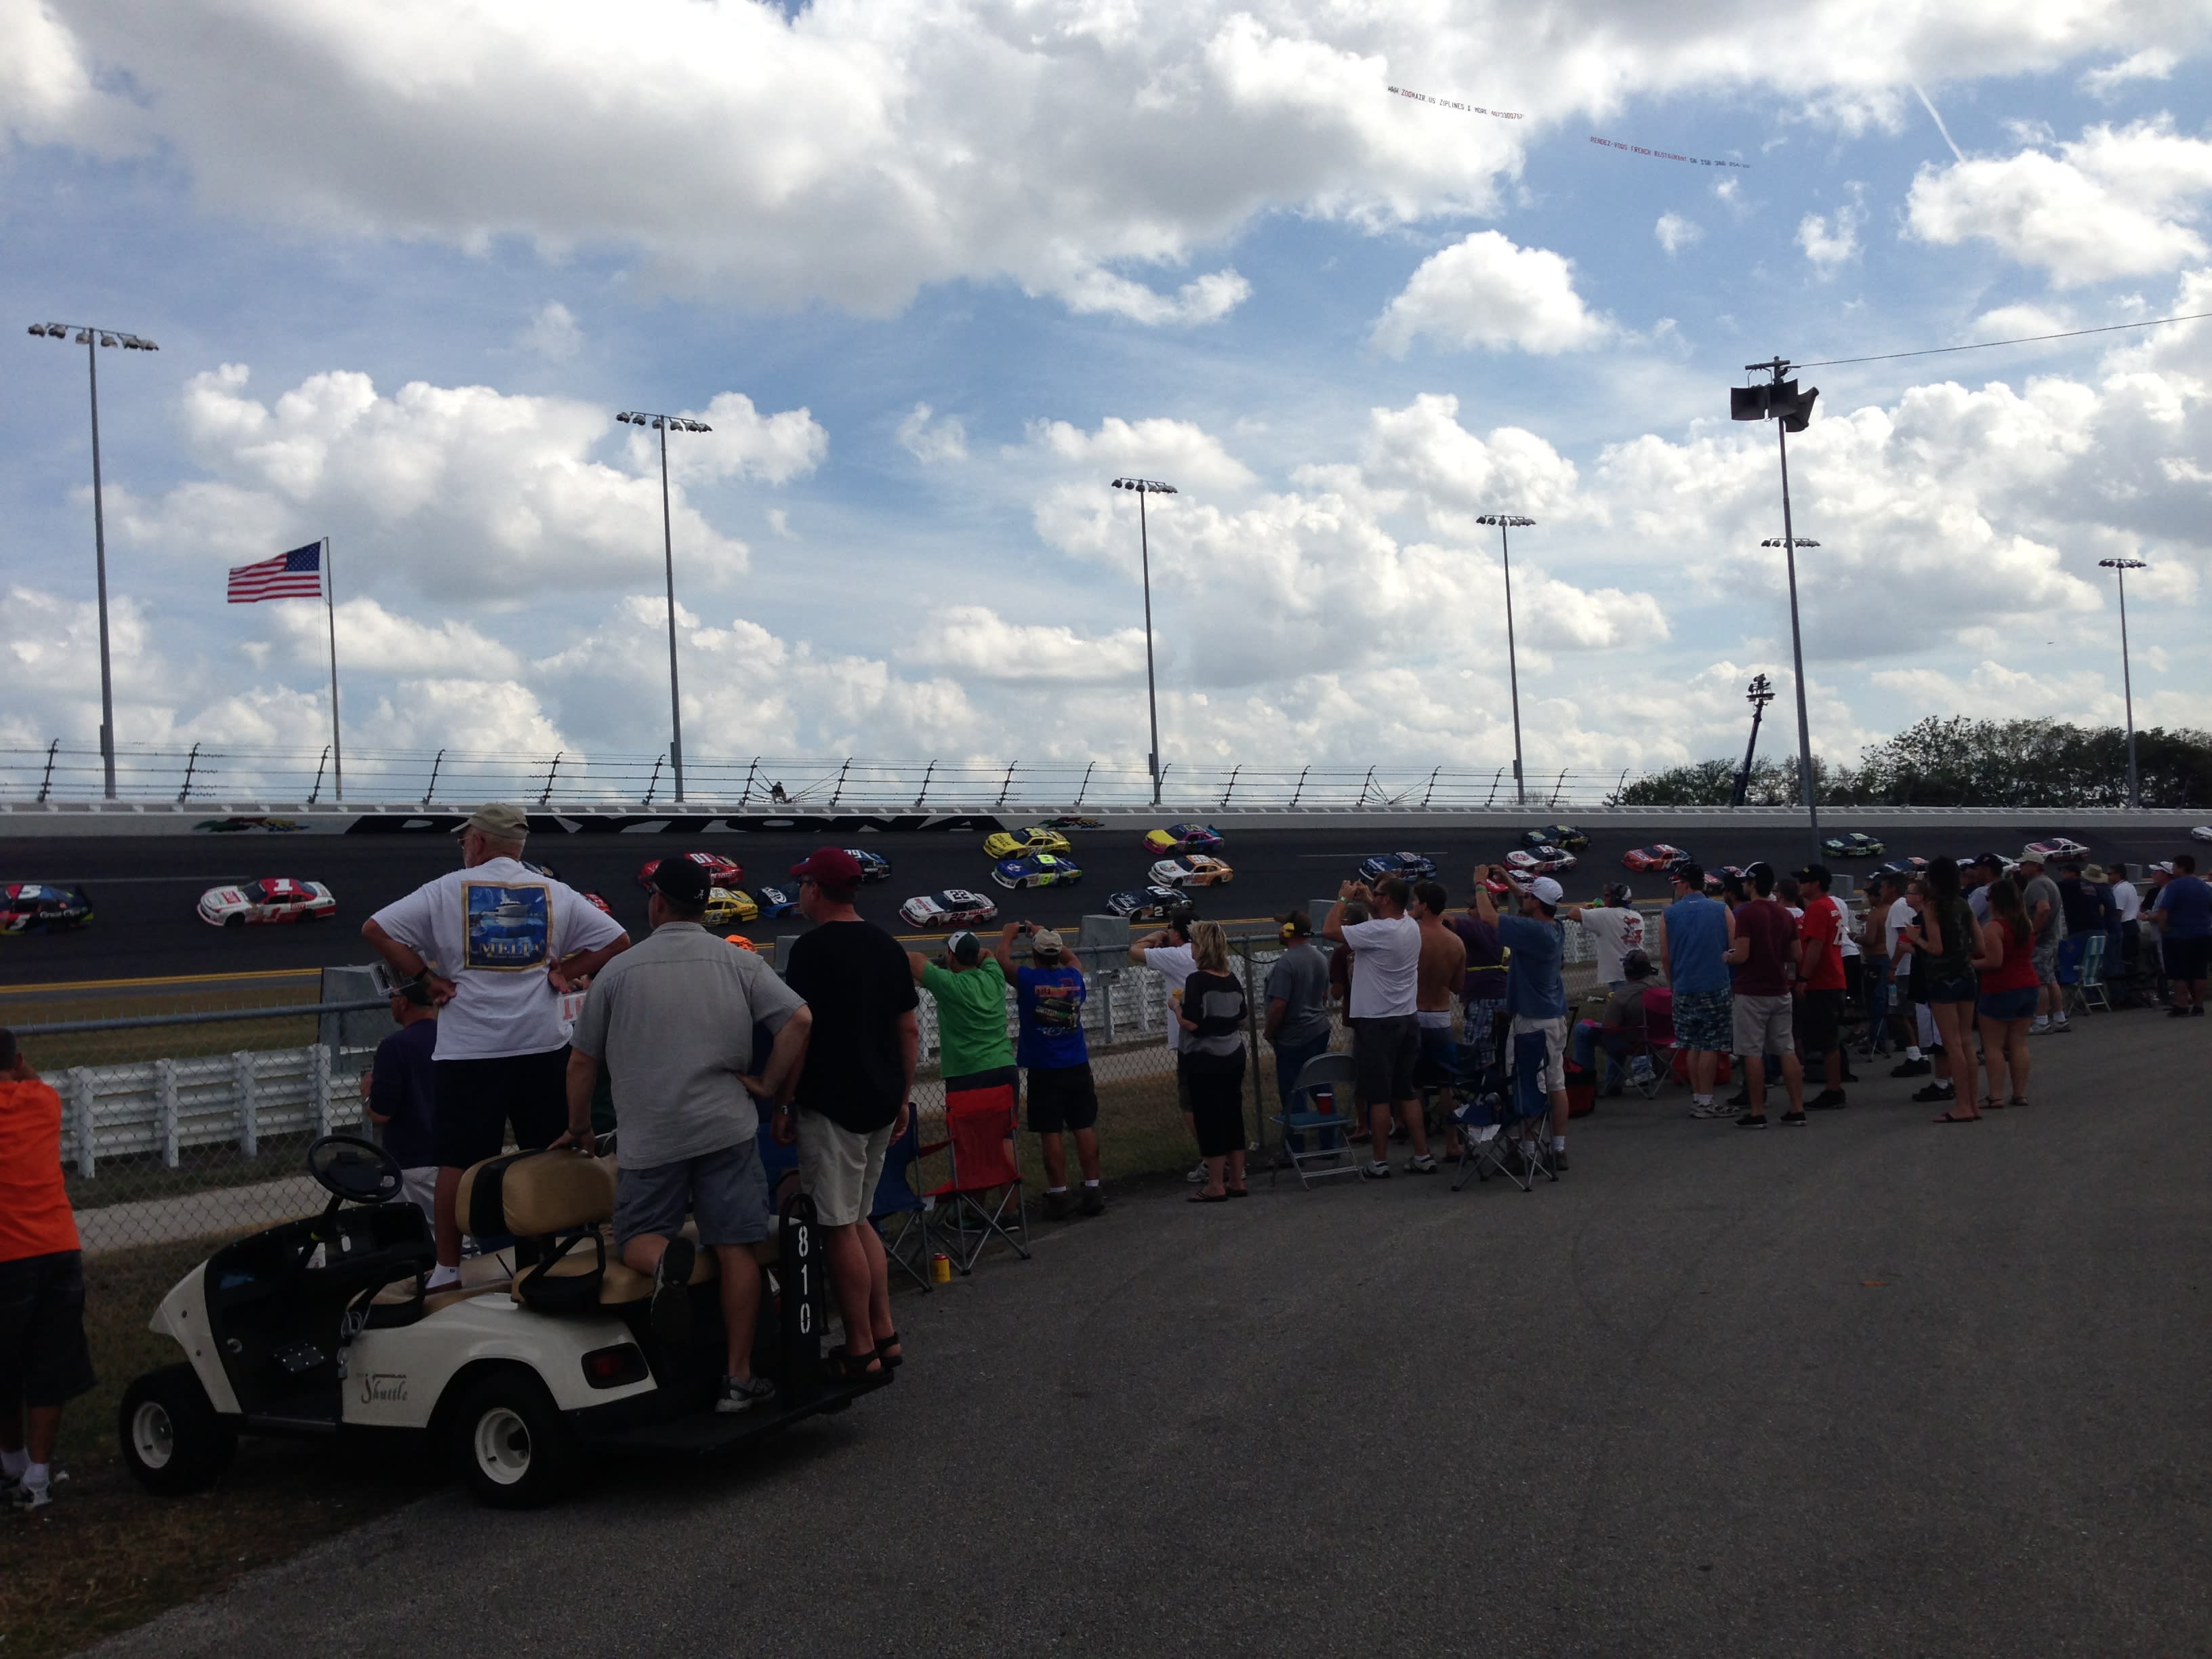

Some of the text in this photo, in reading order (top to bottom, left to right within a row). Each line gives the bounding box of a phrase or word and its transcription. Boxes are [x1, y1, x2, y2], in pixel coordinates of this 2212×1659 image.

[1439, 98, 1464, 110] ZIPLINES
[689, 853, 714, 864] 01
[273, 878, 293, 892] 1
[1147, 885, 1173, 895] 2
[949, 890, 970, 900] 22
[949, 912, 966, 922] 22
[1153, 906, 1164, 917] 2
[798, 1225, 811, 1334] 810
[361, 1373, 408, 1404] Shuttle
